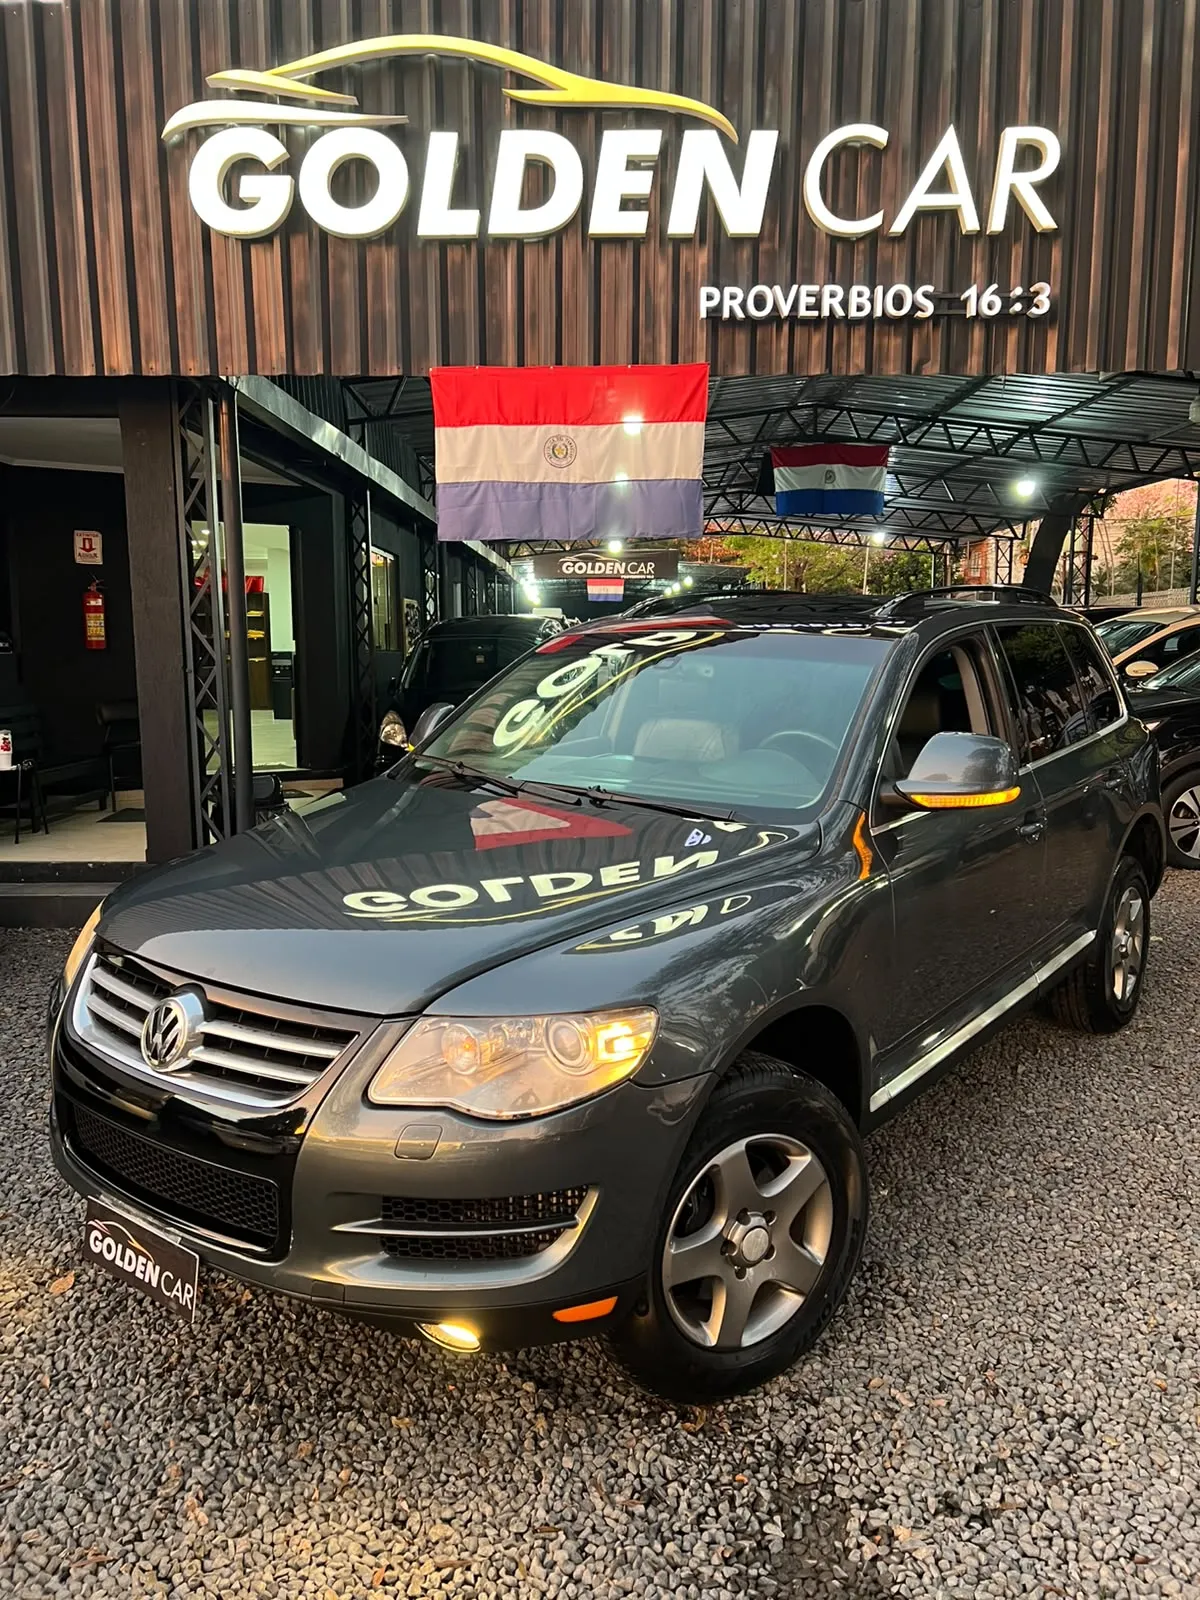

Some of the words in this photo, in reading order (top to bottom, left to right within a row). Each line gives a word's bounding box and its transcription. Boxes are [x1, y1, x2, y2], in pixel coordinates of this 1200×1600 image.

[188, 126, 779, 239] GOLDEN
[803, 124, 1062, 238] CAR
[700, 284, 935, 320] PROVERBIOS
[961, 283, 1052, 319] 16:3
[561, 562, 625, 574] GOLDEN
[627, 562, 655, 574] CAR
[89, 1229, 161, 1288] GOLDEN
[160, 1270, 194, 1310] CAR
